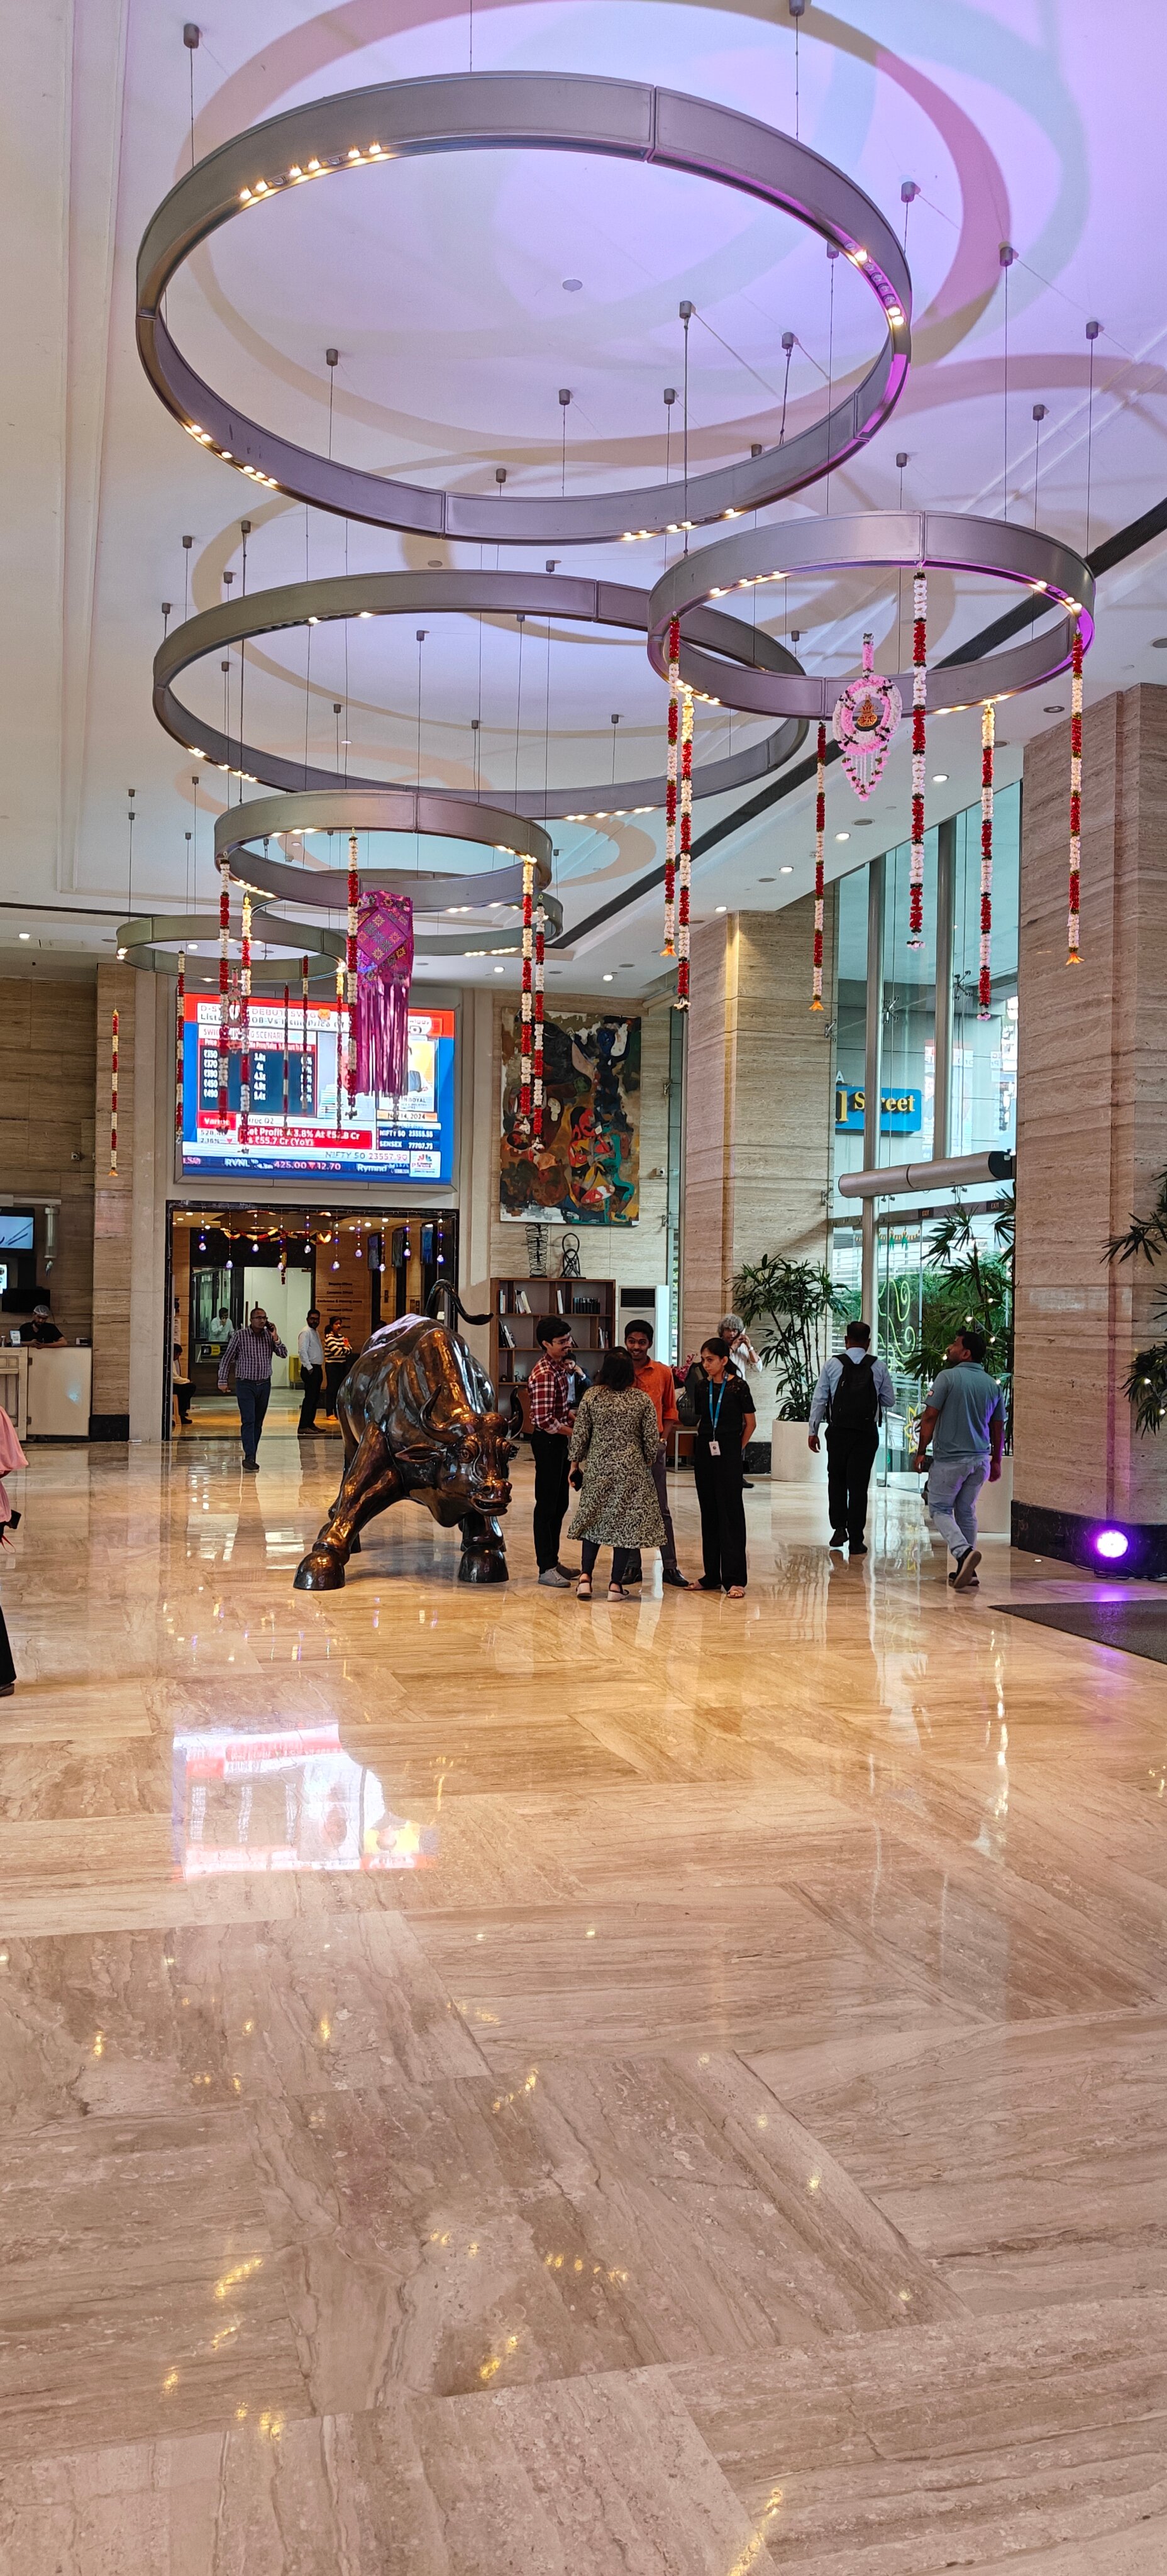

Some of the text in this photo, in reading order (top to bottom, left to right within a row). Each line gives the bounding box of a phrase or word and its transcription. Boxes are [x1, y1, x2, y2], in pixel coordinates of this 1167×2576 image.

[259, 1127, 284, 1136] Profit
[350, 1131, 360, 1140] Cr
[279, 1137, 289, 1145] Cr
[273, 1160, 307, 1170] 425.00
[316, 1161, 341, 1170] 12.70
